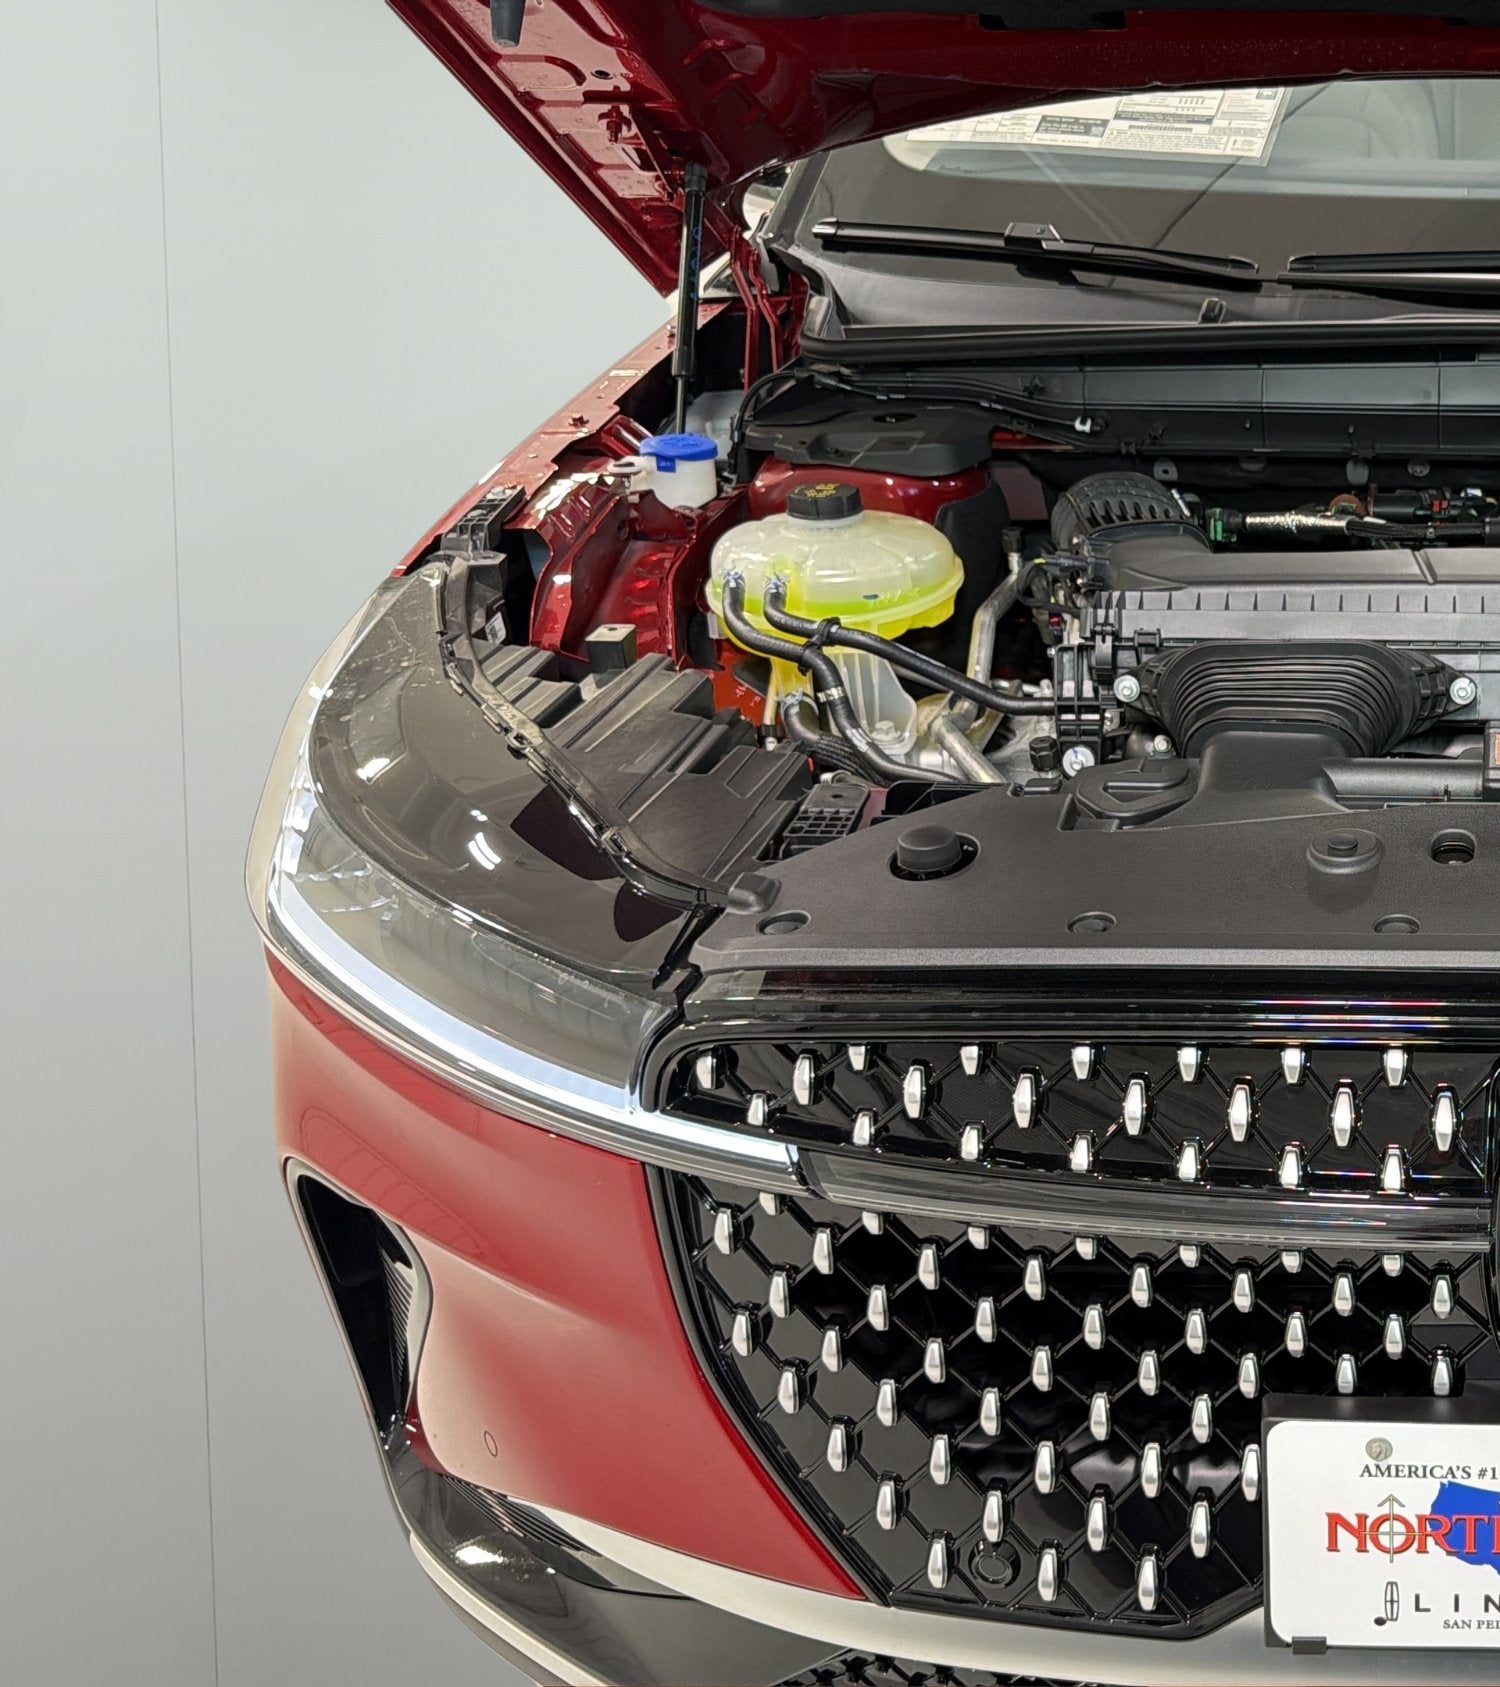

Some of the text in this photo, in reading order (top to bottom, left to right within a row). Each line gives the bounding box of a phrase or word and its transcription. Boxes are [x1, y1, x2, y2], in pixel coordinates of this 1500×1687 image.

[1359, 1463, 1472, 1479] AMERICA'S
[1477, 1466, 1498, 1480] #1
[1442, 1619, 1473, 1630] SAN
